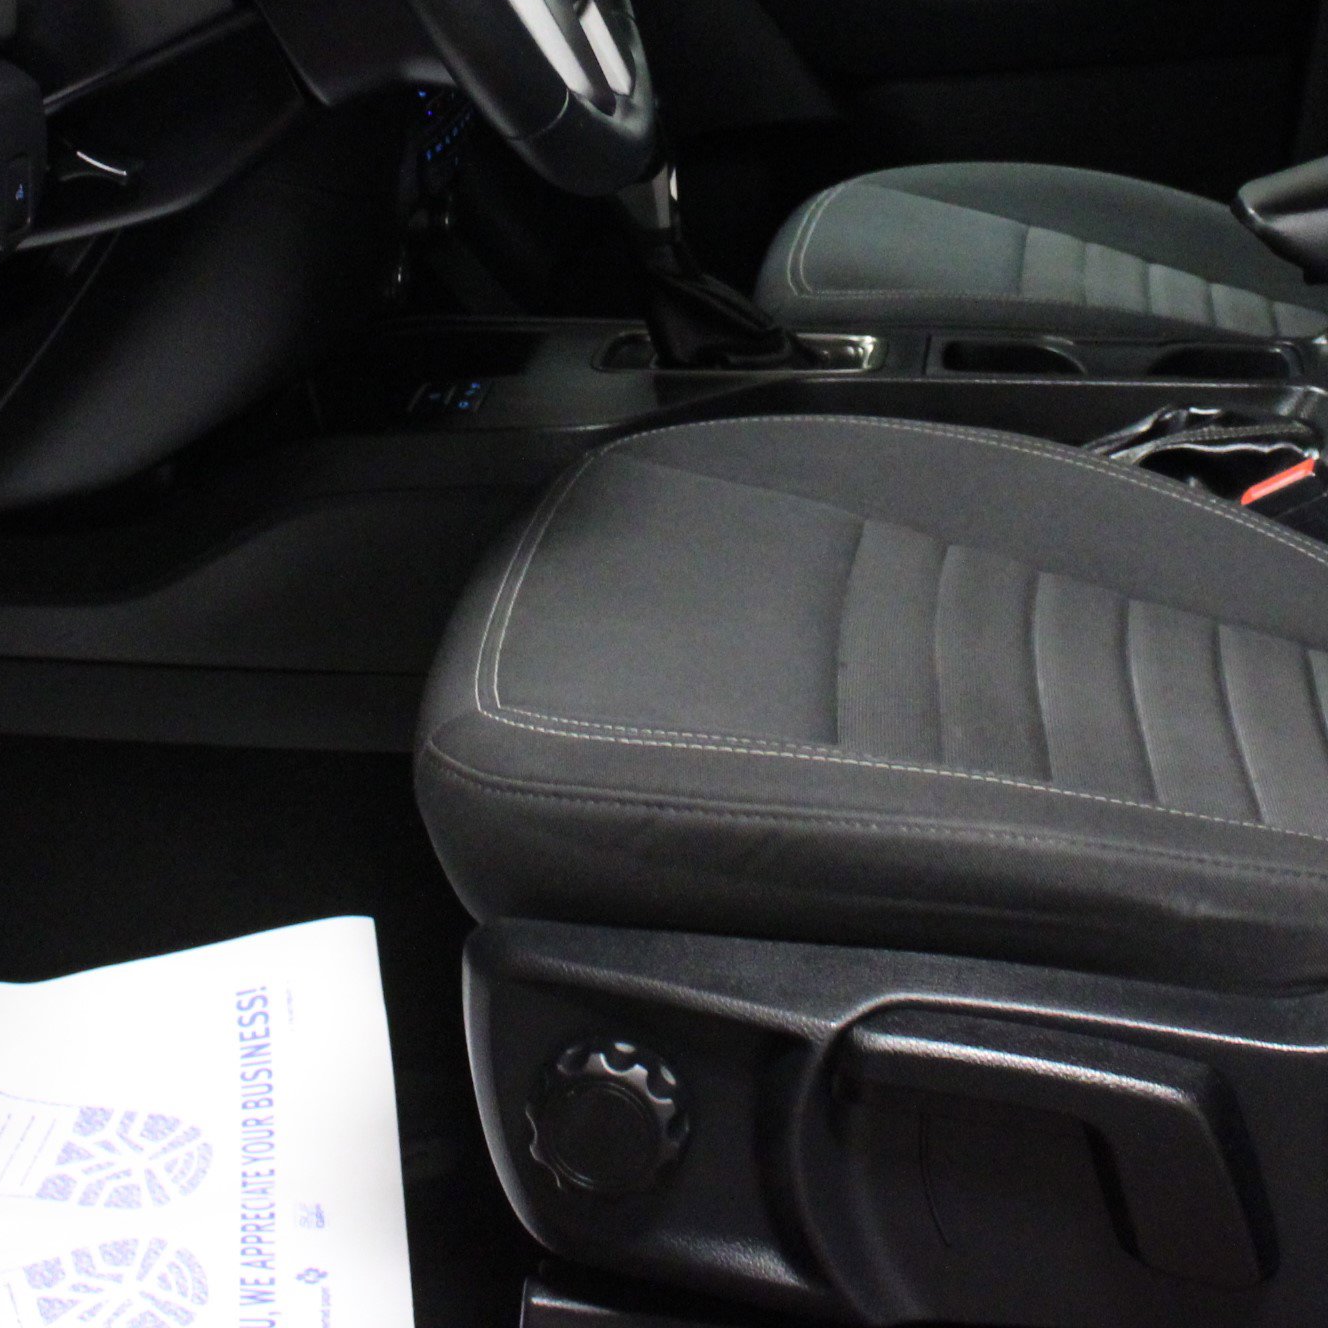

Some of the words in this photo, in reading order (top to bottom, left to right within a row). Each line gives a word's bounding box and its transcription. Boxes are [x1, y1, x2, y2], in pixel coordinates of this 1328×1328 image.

[236, 986, 274, 1111] BUSINESS!
[240, 1115, 276, 1166] YOUR
[239, 1168, 276, 1270] APPRECIATE
[239, 1277, 276, 1306] WE
